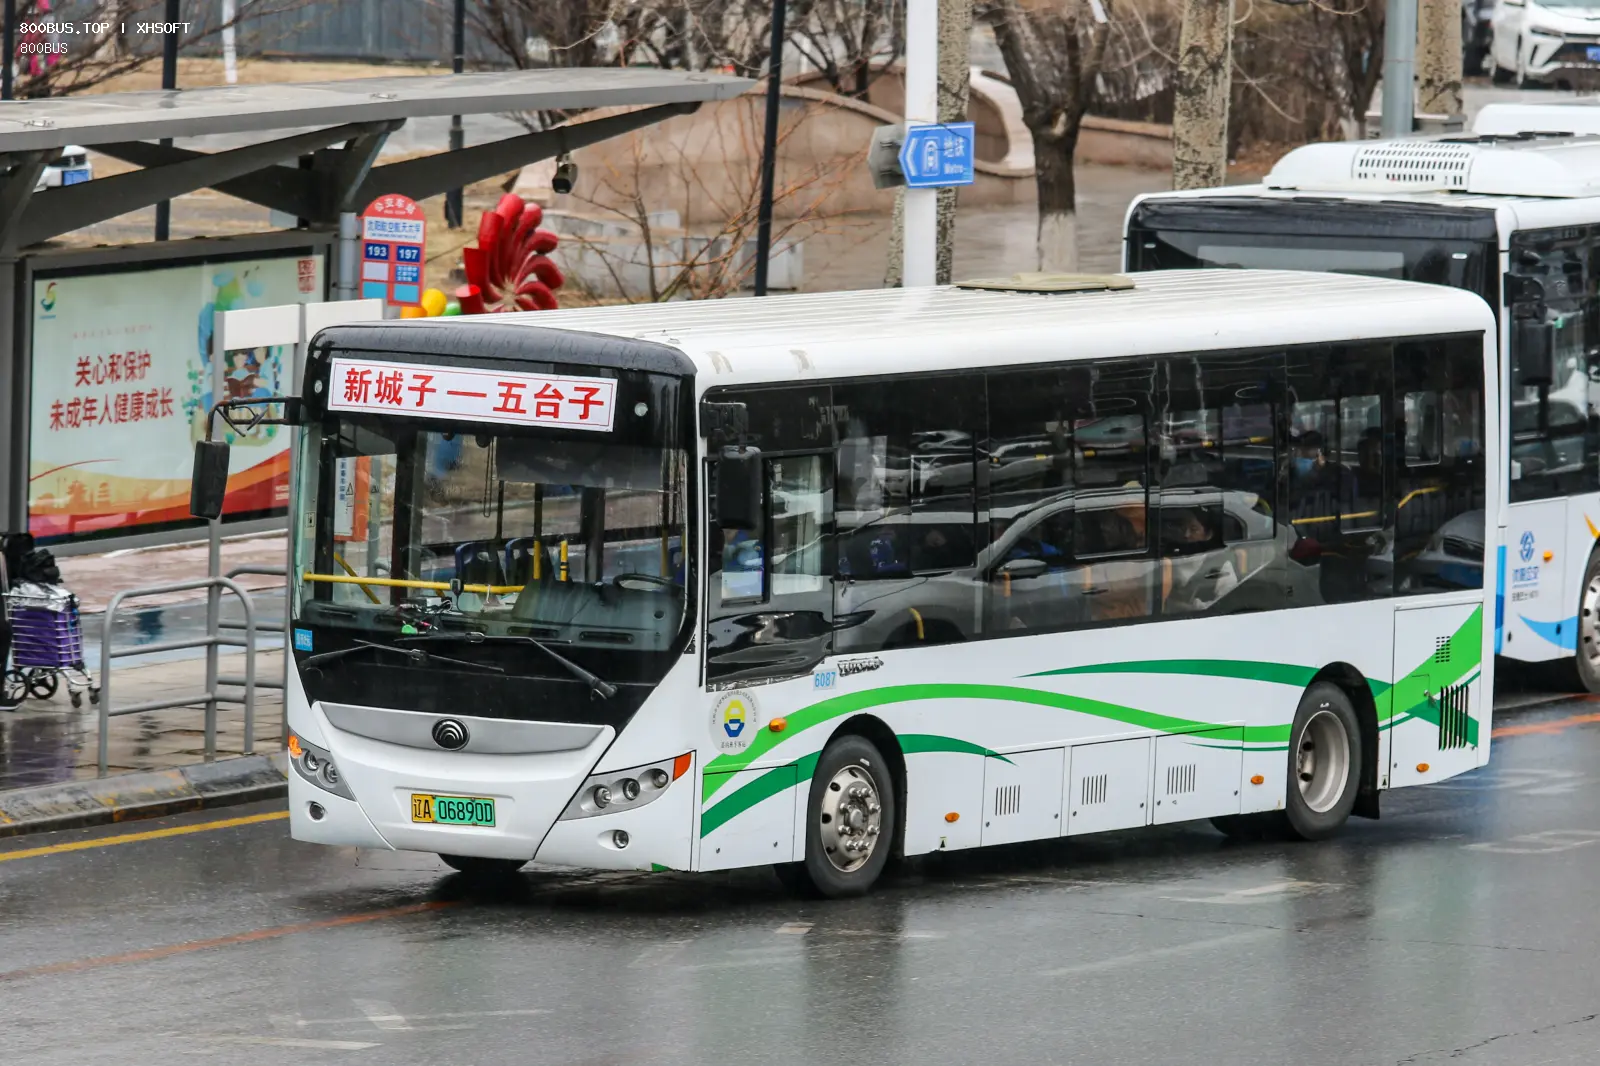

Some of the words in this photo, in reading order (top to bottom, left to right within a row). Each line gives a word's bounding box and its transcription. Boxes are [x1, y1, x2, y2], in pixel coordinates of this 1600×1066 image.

[367, 245, 387, 257] 193
[398, 248, 418, 260] 197
[75, 349, 152, 388] 关心和保护
[49, 386, 174, 432] 未成年人健康成长
[814, 671, 837, 688] 6087
